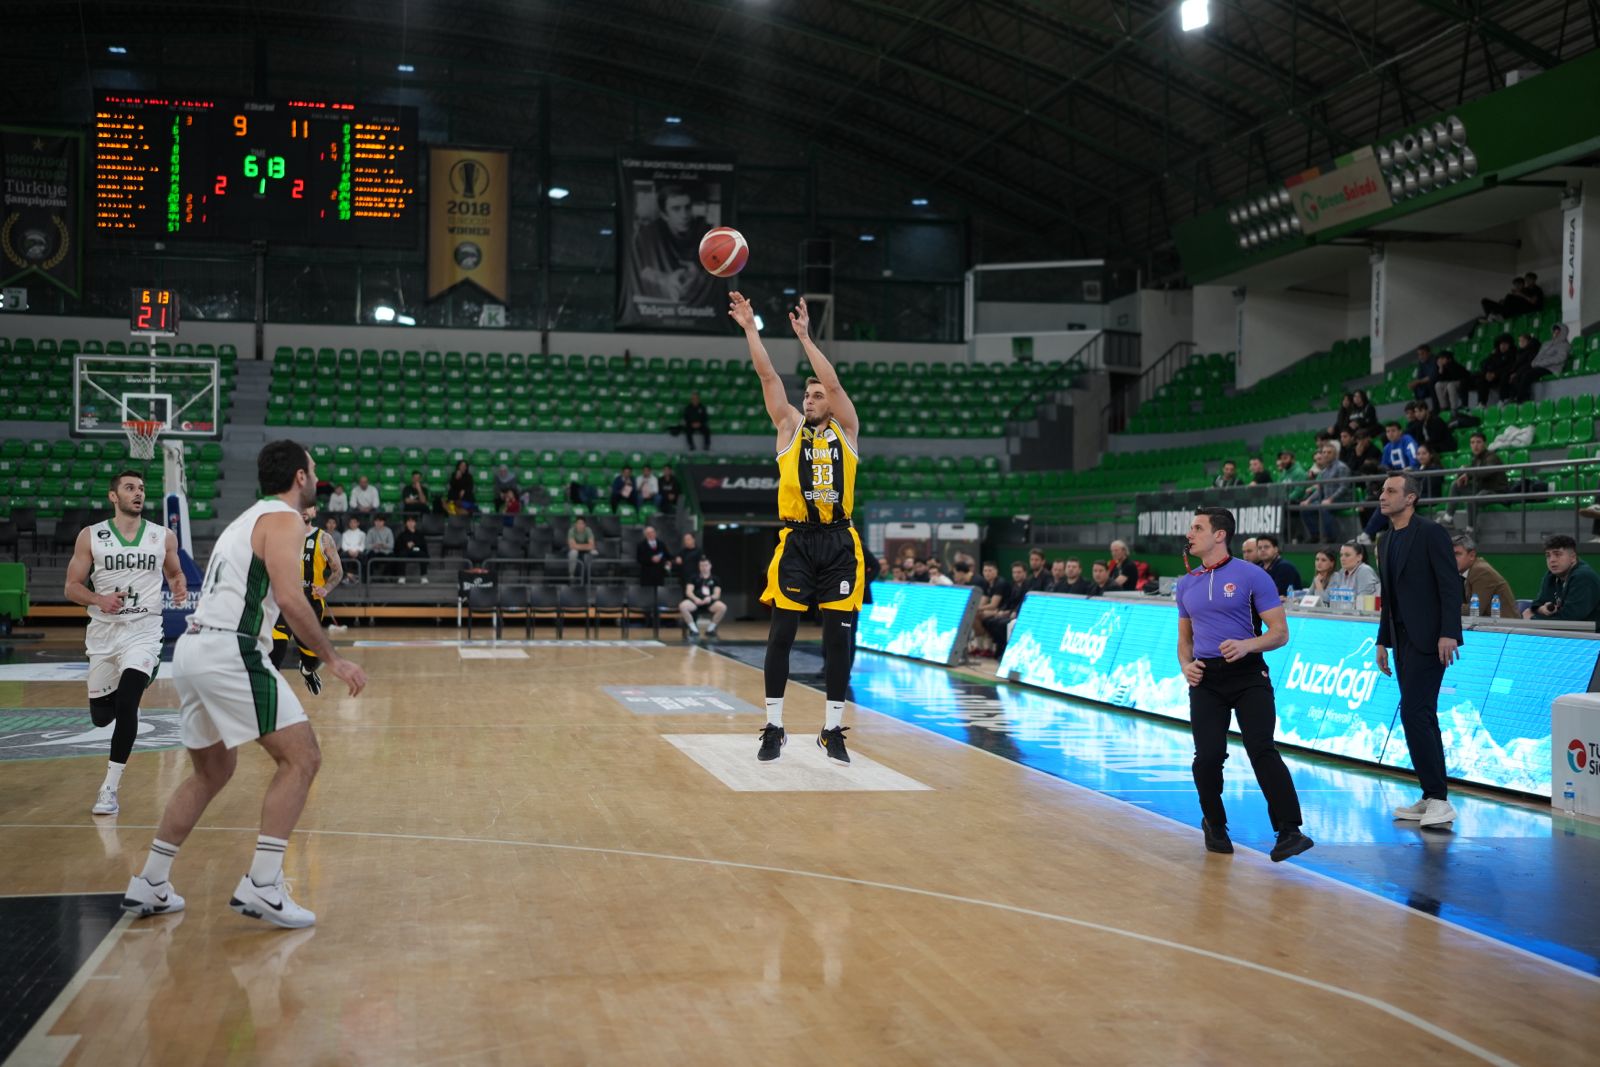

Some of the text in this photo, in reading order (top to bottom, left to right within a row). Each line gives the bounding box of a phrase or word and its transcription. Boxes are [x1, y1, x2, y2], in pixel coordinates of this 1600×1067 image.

[233, 115, 248, 137] 9
[291, 119, 308, 139] 11
[244, 155, 285, 179] 6 13
[5, 179, 67, 199] Türkiye
[214, 175, 228, 195] 2
[259, 177, 266, 194] 1
[292, 179, 304, 199] 2
[447, 201, 490, 216] 2018
[142, 290, 170, 305] 6 13
[138, 306, 167, 329] 21
[488, 312, 498, 324] K
[804, 447, 839, 461] KONYA
[812, 464, 834, 486] 33
[1285, 652, 1379, 710] buzdağı
